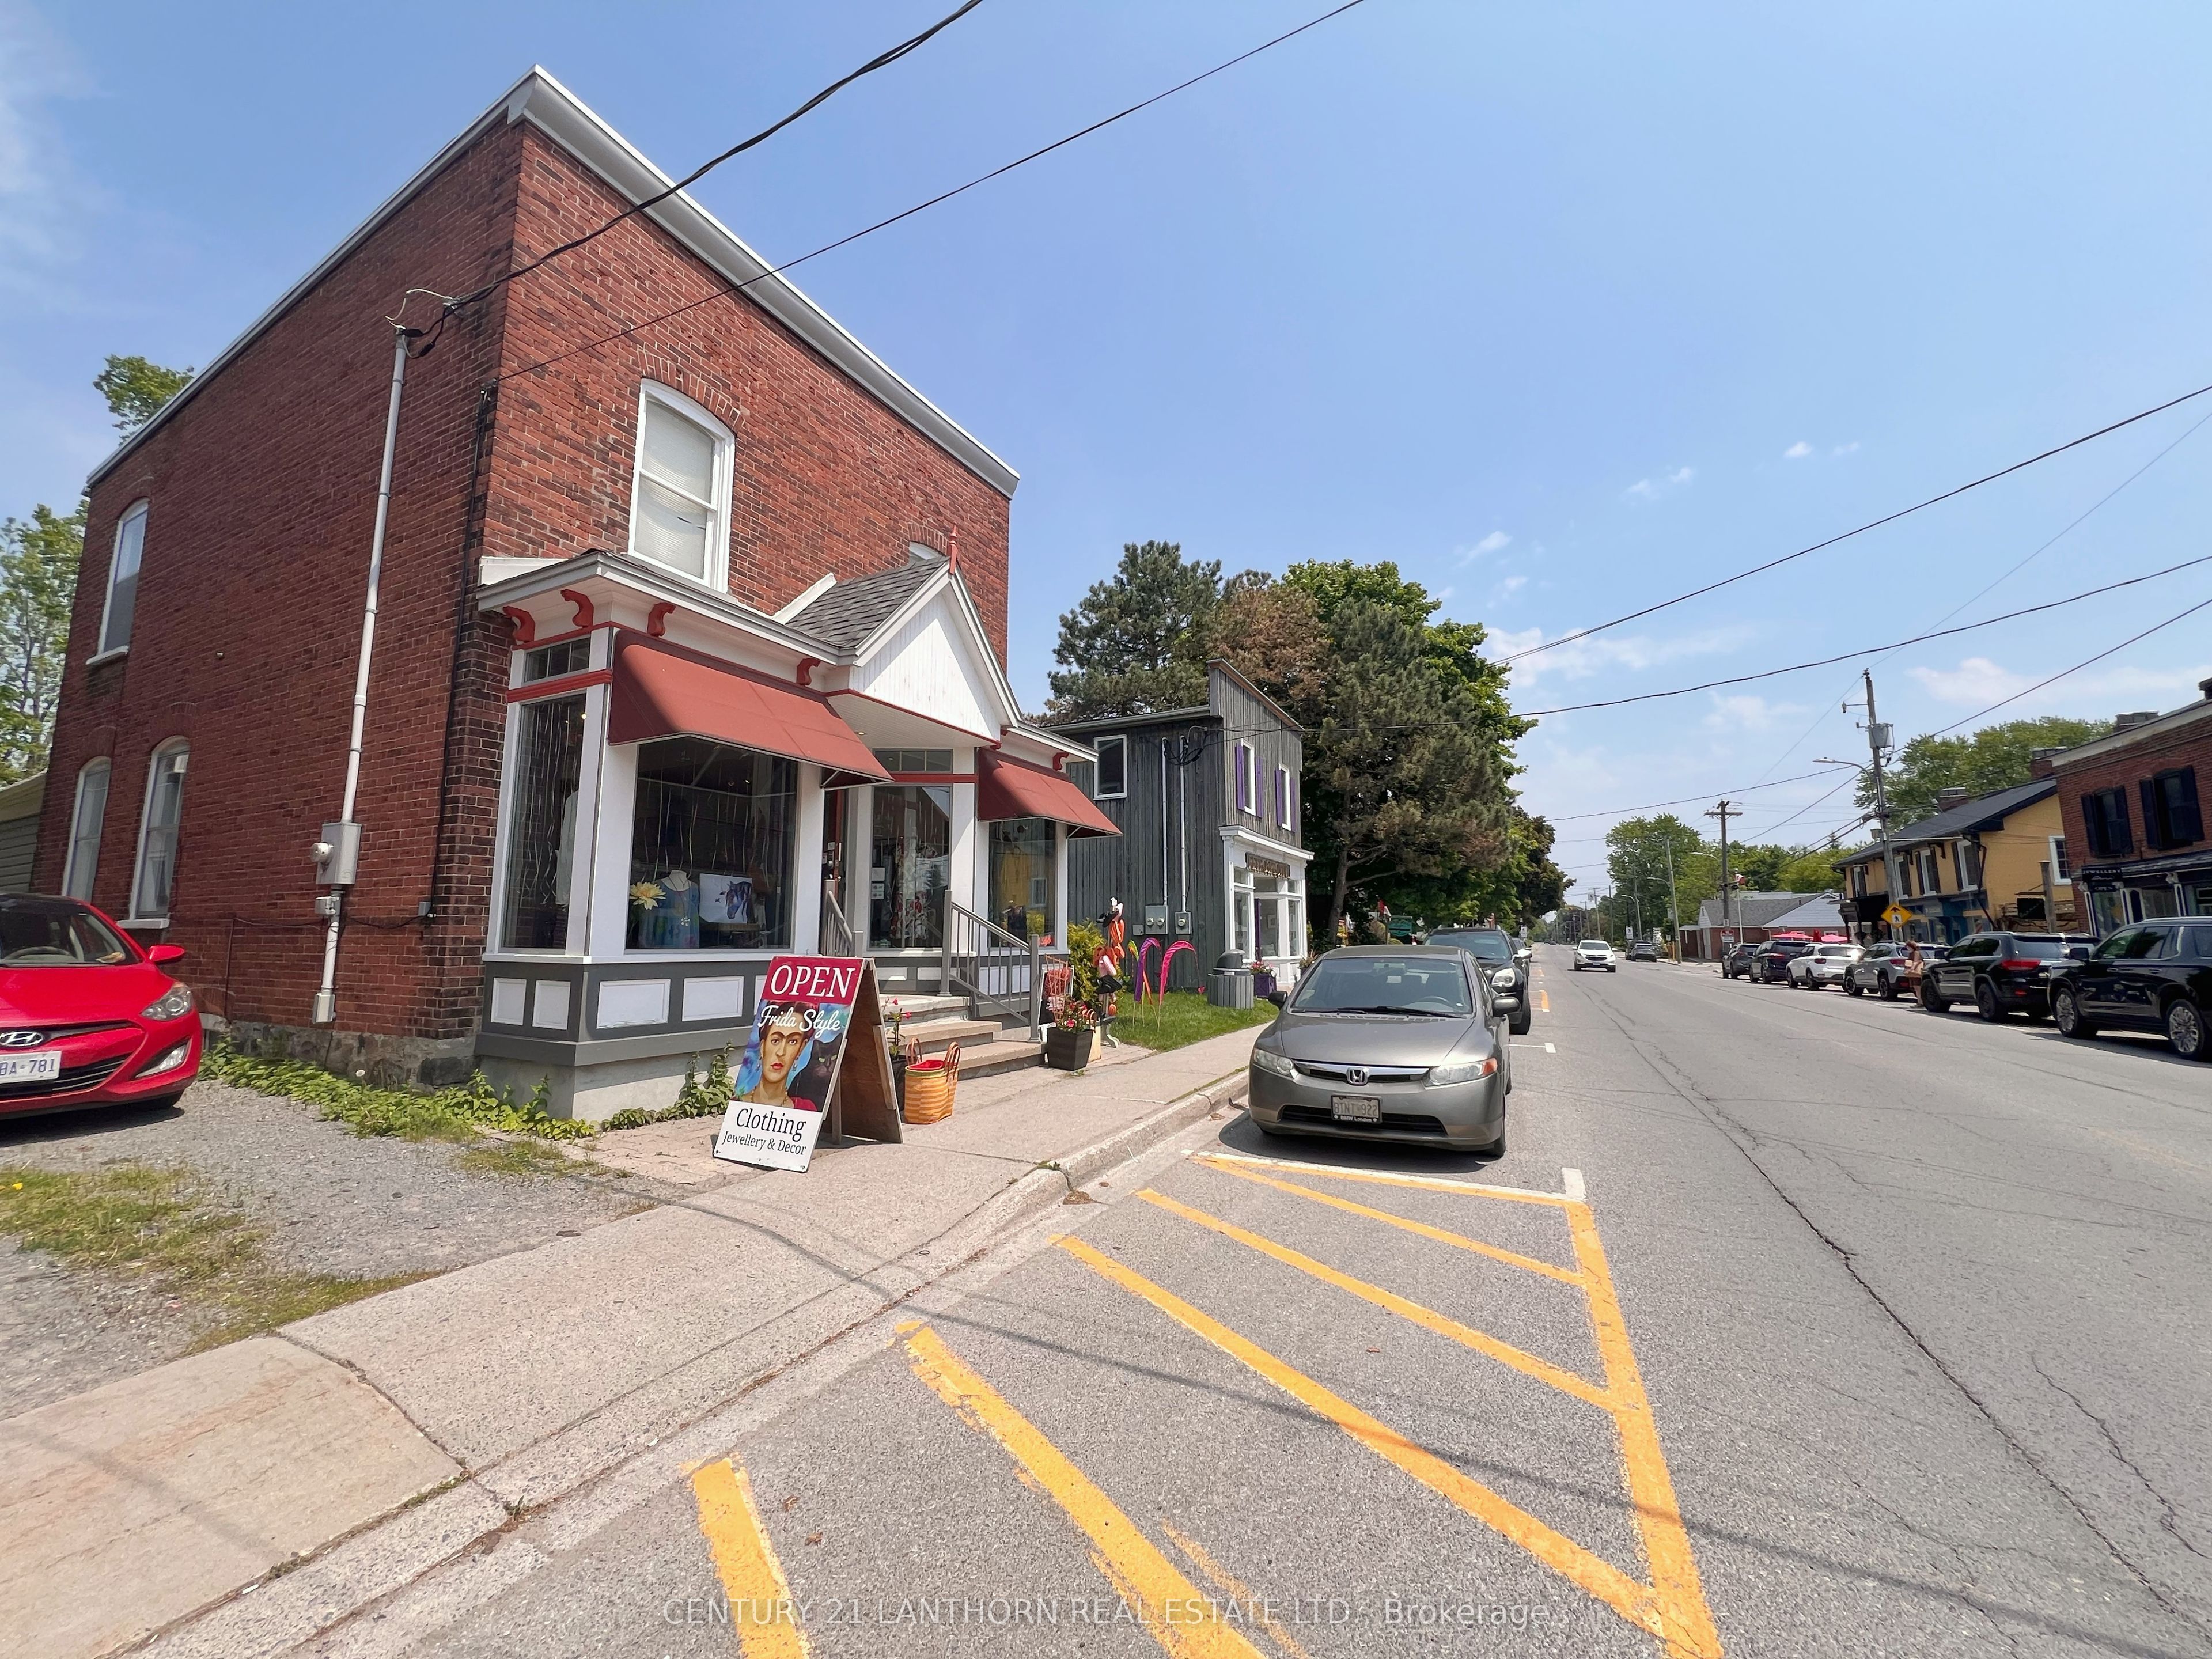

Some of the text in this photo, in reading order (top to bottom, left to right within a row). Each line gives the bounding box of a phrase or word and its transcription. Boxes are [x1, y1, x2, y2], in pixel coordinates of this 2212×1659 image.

[771, 965, 856, 998] OPEN
[757, 1005, 841, 1039] Frida Style
[29, 1058, 55, 1074] 781
[1361, 1104, 1378, 1116] 922
[736, 1108, 806, 1142] Clothing
[721, 1131, 807, 1155] Jewellery & Decor
